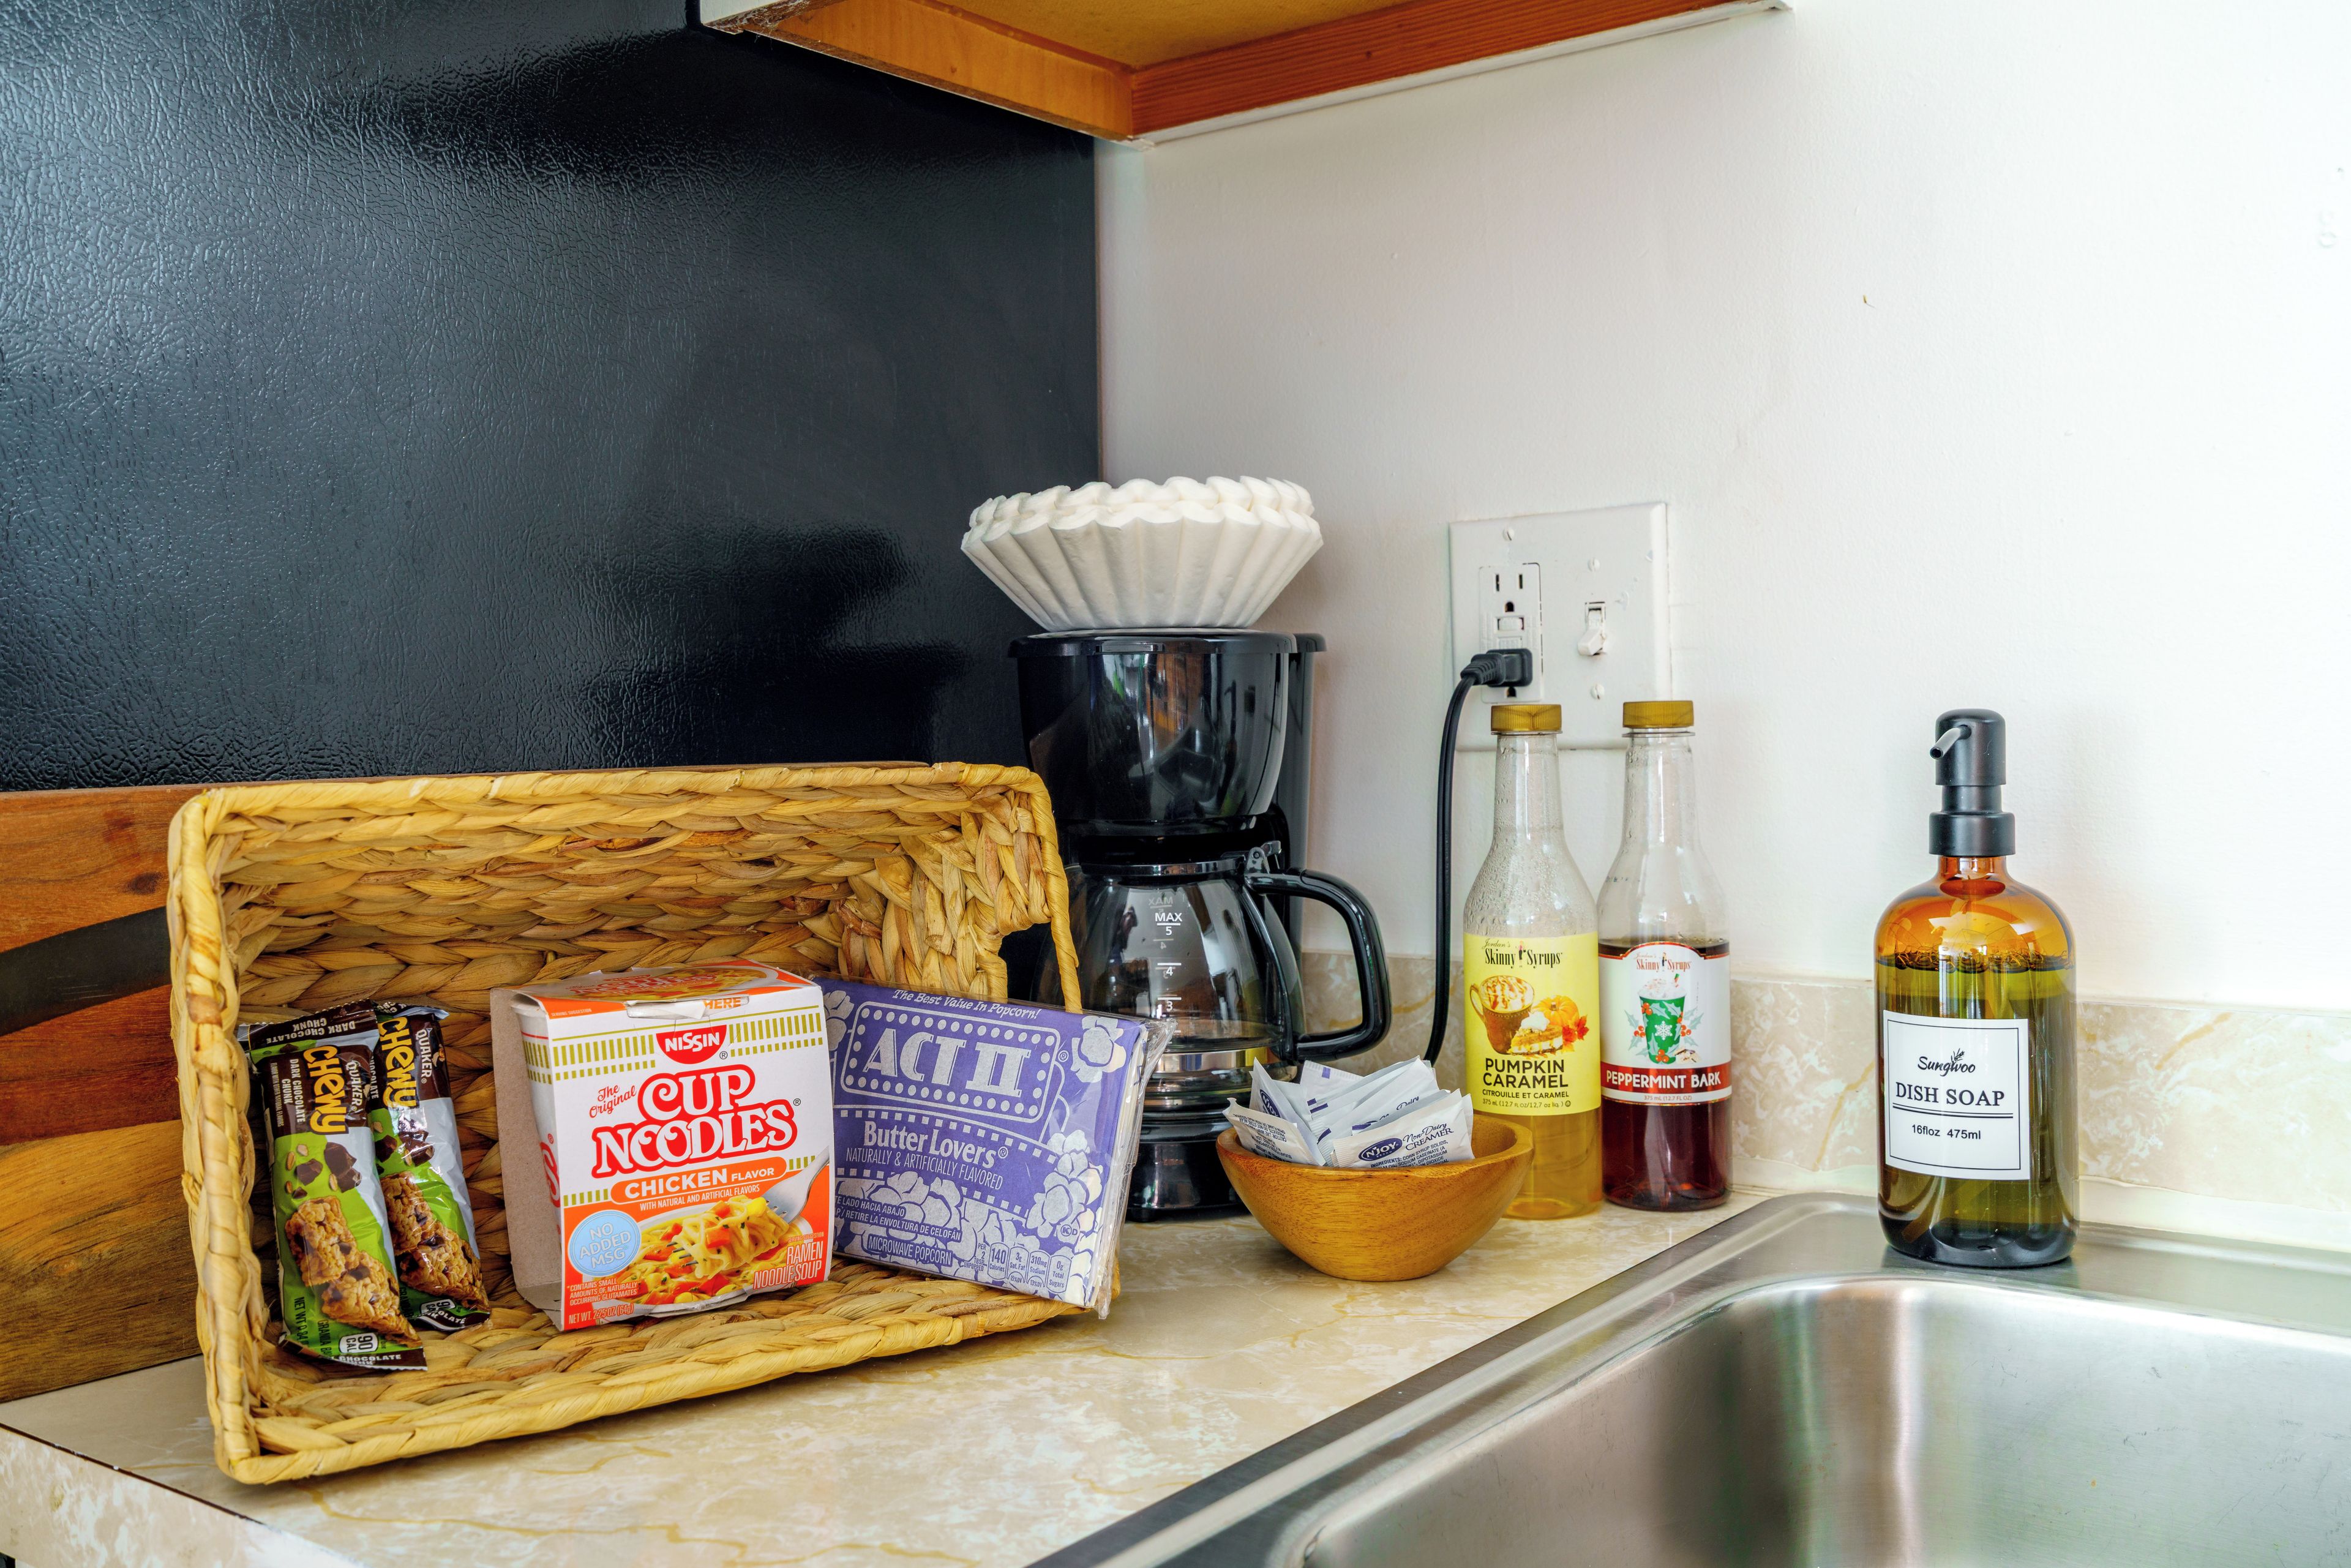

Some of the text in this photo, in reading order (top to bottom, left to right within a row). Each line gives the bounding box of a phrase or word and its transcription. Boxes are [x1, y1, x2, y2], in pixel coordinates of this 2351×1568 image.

[1155, 912, 1182, 922] MAX
[1166, 926, 1172, 936] 5
[1482, 938, 1511, 949] Jordan's
[1485, 948, 1561, 969] Skinny Syrups
[1637, 959, 1691, 972] Skinny Syrups
[1166, 966, 1173, 976] 4
[703, 997, 741, 1010] HERE
[892, 989, 1042, 1019] The Best Value In Popcorn!
[1166, 1001, 1173, 1011] 3
[266, 1021, 356, 1044] DARK CHOCOLATE
[293, 1018, 327, 1031] CHUNK
[665, 1032, 720, 1052] NISSIN
[862, 1027, 1032, 1098] ACT II
[1485, 1058, 1564, 1074] PUMPKIN
[1917, 1055, 1976, 1077] Sungwoo
[1483, 1072, 1569, 1089] CARAMEL
[1607, 1070, 1721, 1089] PEPPERMINT BARK
[282, 1078, 293, 1104] CHUNK
[290, 1059, 306, 1123] DARK CHOCOLATE
[597, 1084, 620, 1102] The
[642, 1069, 751, 1120] CUP
[1482, 1089, 1520, 1098] CITROUILLE
[1895, 1082, 2005, 1106] DISH SOAP
[589, 1084, 637, 1119] Original
[594, 1104, 794, 1174] NOODLES
[864, 1120, 928, 1152] Butter
[1403, 1123, 1447, 1143] Non-Dairy
[1406, 1128, 1454, 1150] CREAMER
[1911, 1125, 1981, 1140] 16floz 475ml
[1367, 1141, 1397, 1158] N'JOY
[1370, 1158, 1402, 1168] INGREDIENTS:
[1416, 1146, 1430, 1155] SYRUP
[1431, 1140, 1449, 1149] SOLIDS,
[1398, 1157, 1415, 1166] SODIUM
[1416, 1150, 1439, 1160] CASEINATE
[1417, 1150, 1447, 1164] DIPOTASSIUM
[846, 1147, 1003, 1190] NATURALLY & ARTIFICIALLY FLAVORED
[1426, 1156, 1444, 1166] DIOXIDE
[624, 1166, 774, 1199] CHICKEN FLAVOR
[640, 1184, 760, 1212] WITH NATURAL AND ARTIFICIAL FLAVORS
[842, 1197, 860, 1207] LADO
[861, 1201, 881, 1212] HACIA
[882, 1204, 905, 1217] ABAJO
[590, 1223, 613, 1240] NO
[846, 1210, 961, 1240] RETIRE LA ENVOLTURA DE CELOFÁN
[580, 1231, 631, 1259] ADDED
[787, 1240, 823, 1266] RAMEN
[868, 1236, 951, 1266] MICROWAVE POPCORN
[981, 1251, 985, 1259] 2
[991, 1248, 1007, 1264] 140
[1016, 1253, 1022, 1262] 3g
[1031, 1256, 1047, 1268] 310mg
[753, 1260, 822, 1289] NOODLE SOUP
[964, 1262, 984, 1272] UNPOPPED
[1030, 1267, 1045, 1275] Sodium
[1057, 1261, 1063, 1271] 0g
[570, 1288, 598, 1299] AMOUNTS
[607, 1281, 638, 1292] NATURALLY
[599, 1277, 618, 1288] SMALL
[1049, 1280, 1064, 1289] Sugars
[294, 1297, 306, 1310] NET
[570, 1289, 637, 1306] OCCURRING GLUTAMATES
[569, 1313, 580, 1324] NET
[593, 1308, 607, 1320] 2.25
[607, 1306, 616, 1316] OZ
[617, 1304, 634, 1316] (64g)
[347, 1337, 356, 1352] CAL
[358, 1334, 373, 1350] 90
